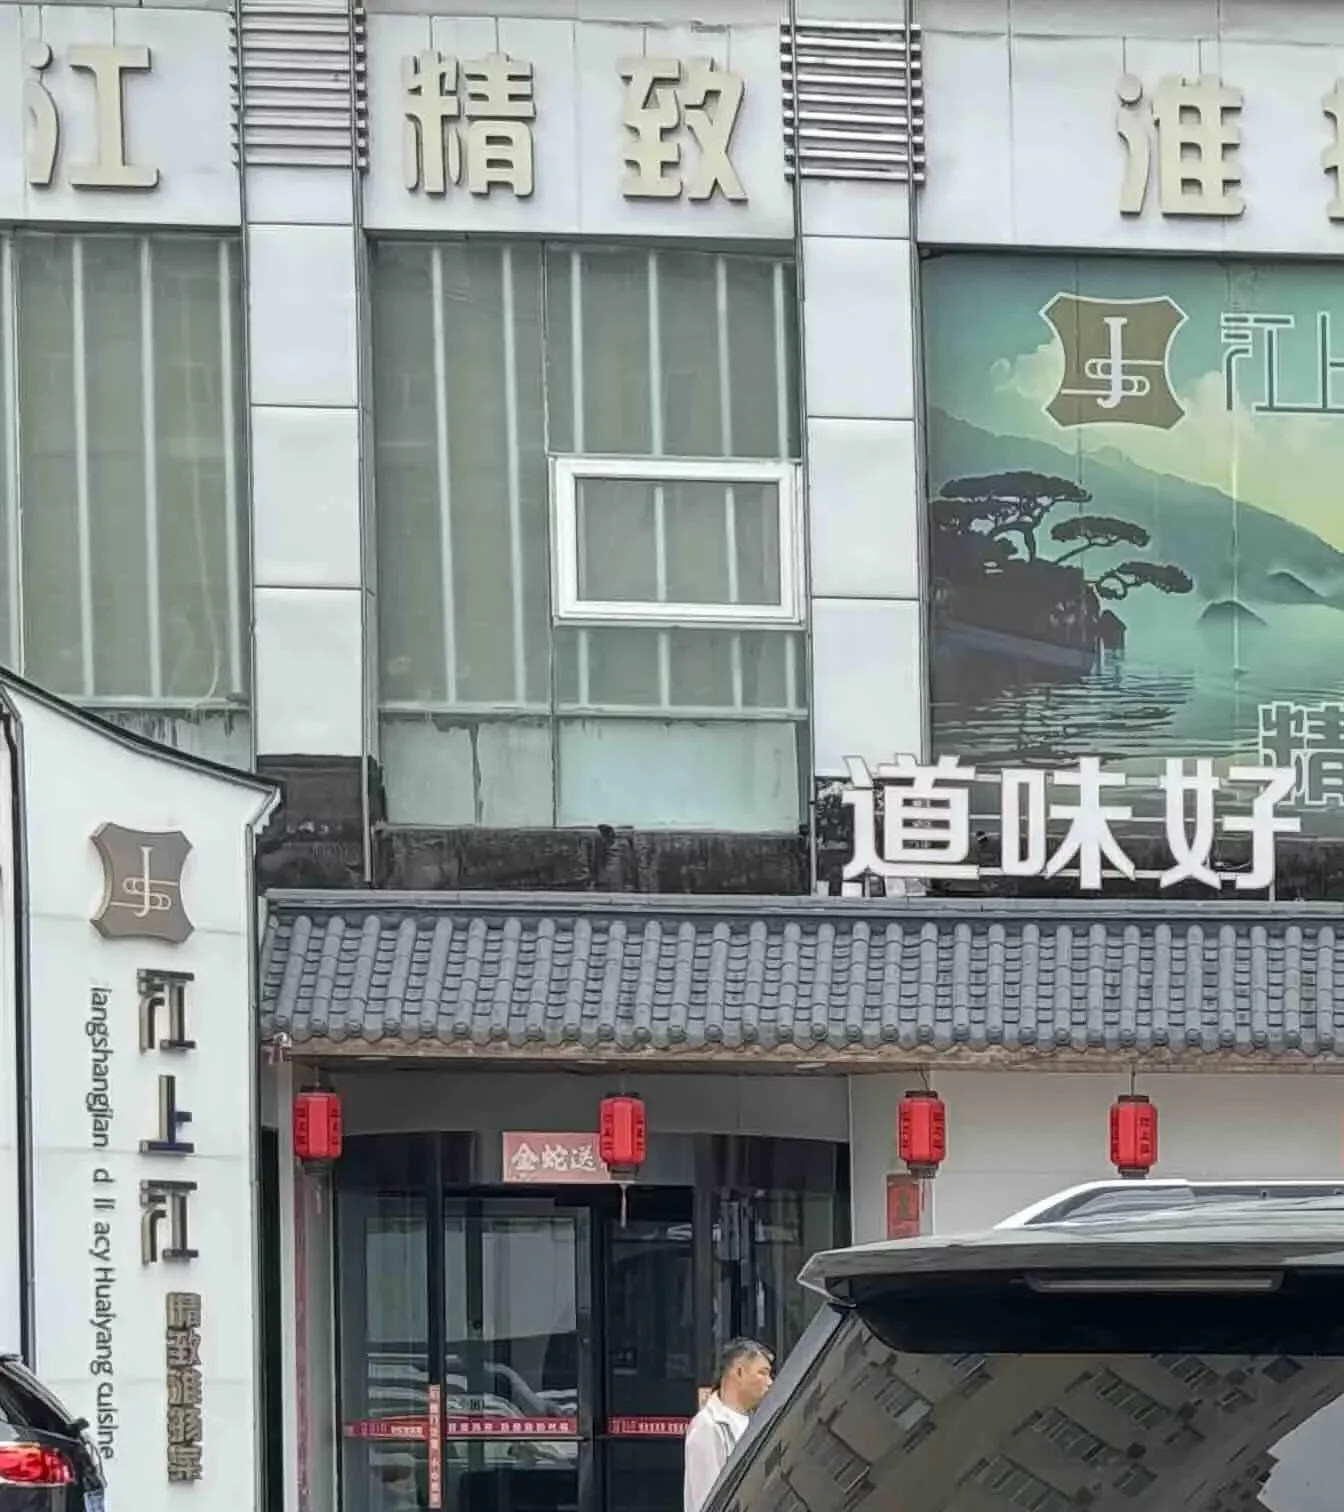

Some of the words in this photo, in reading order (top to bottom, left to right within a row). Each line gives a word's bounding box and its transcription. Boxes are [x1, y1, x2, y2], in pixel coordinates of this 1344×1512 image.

[28, 42, 159, 189] 江
[404, 49, 747, 203] 精致
[136, 967, 200, 1266] 江上江
[511, 1142, 609, 1173] 金蛇送
[88, 1267, 118, 1376] Huaiyang
[96, 1382, 120, 1461] cuisine
